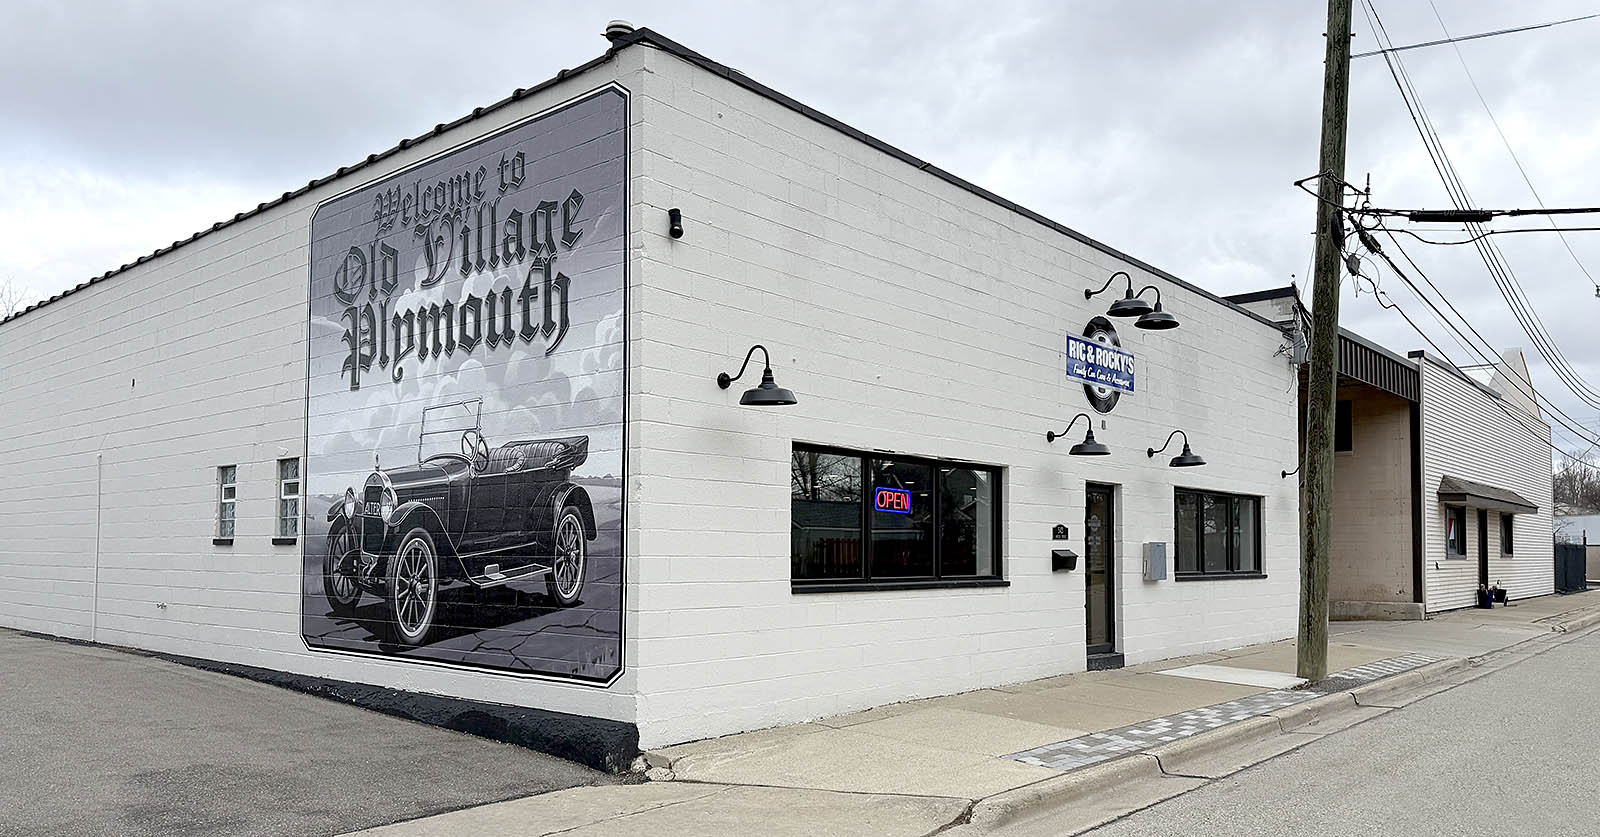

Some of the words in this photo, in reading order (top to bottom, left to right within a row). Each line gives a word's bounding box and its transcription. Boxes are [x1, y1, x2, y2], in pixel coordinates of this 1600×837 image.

[373, 164, 487, 236] Welcome
[497, 150, 526, 192] to
[334, 239, 399, 305] Old
[413, 187, 585, 288] Village
[340, 255, 572, 391] Plymouth
[1069, 340, 1086, 362] RIC
[1087, 345, 1095, 364] &
[1096, 347, 1134, 375] ROCKY'S
[877, 490, 909, 510] OPEN
